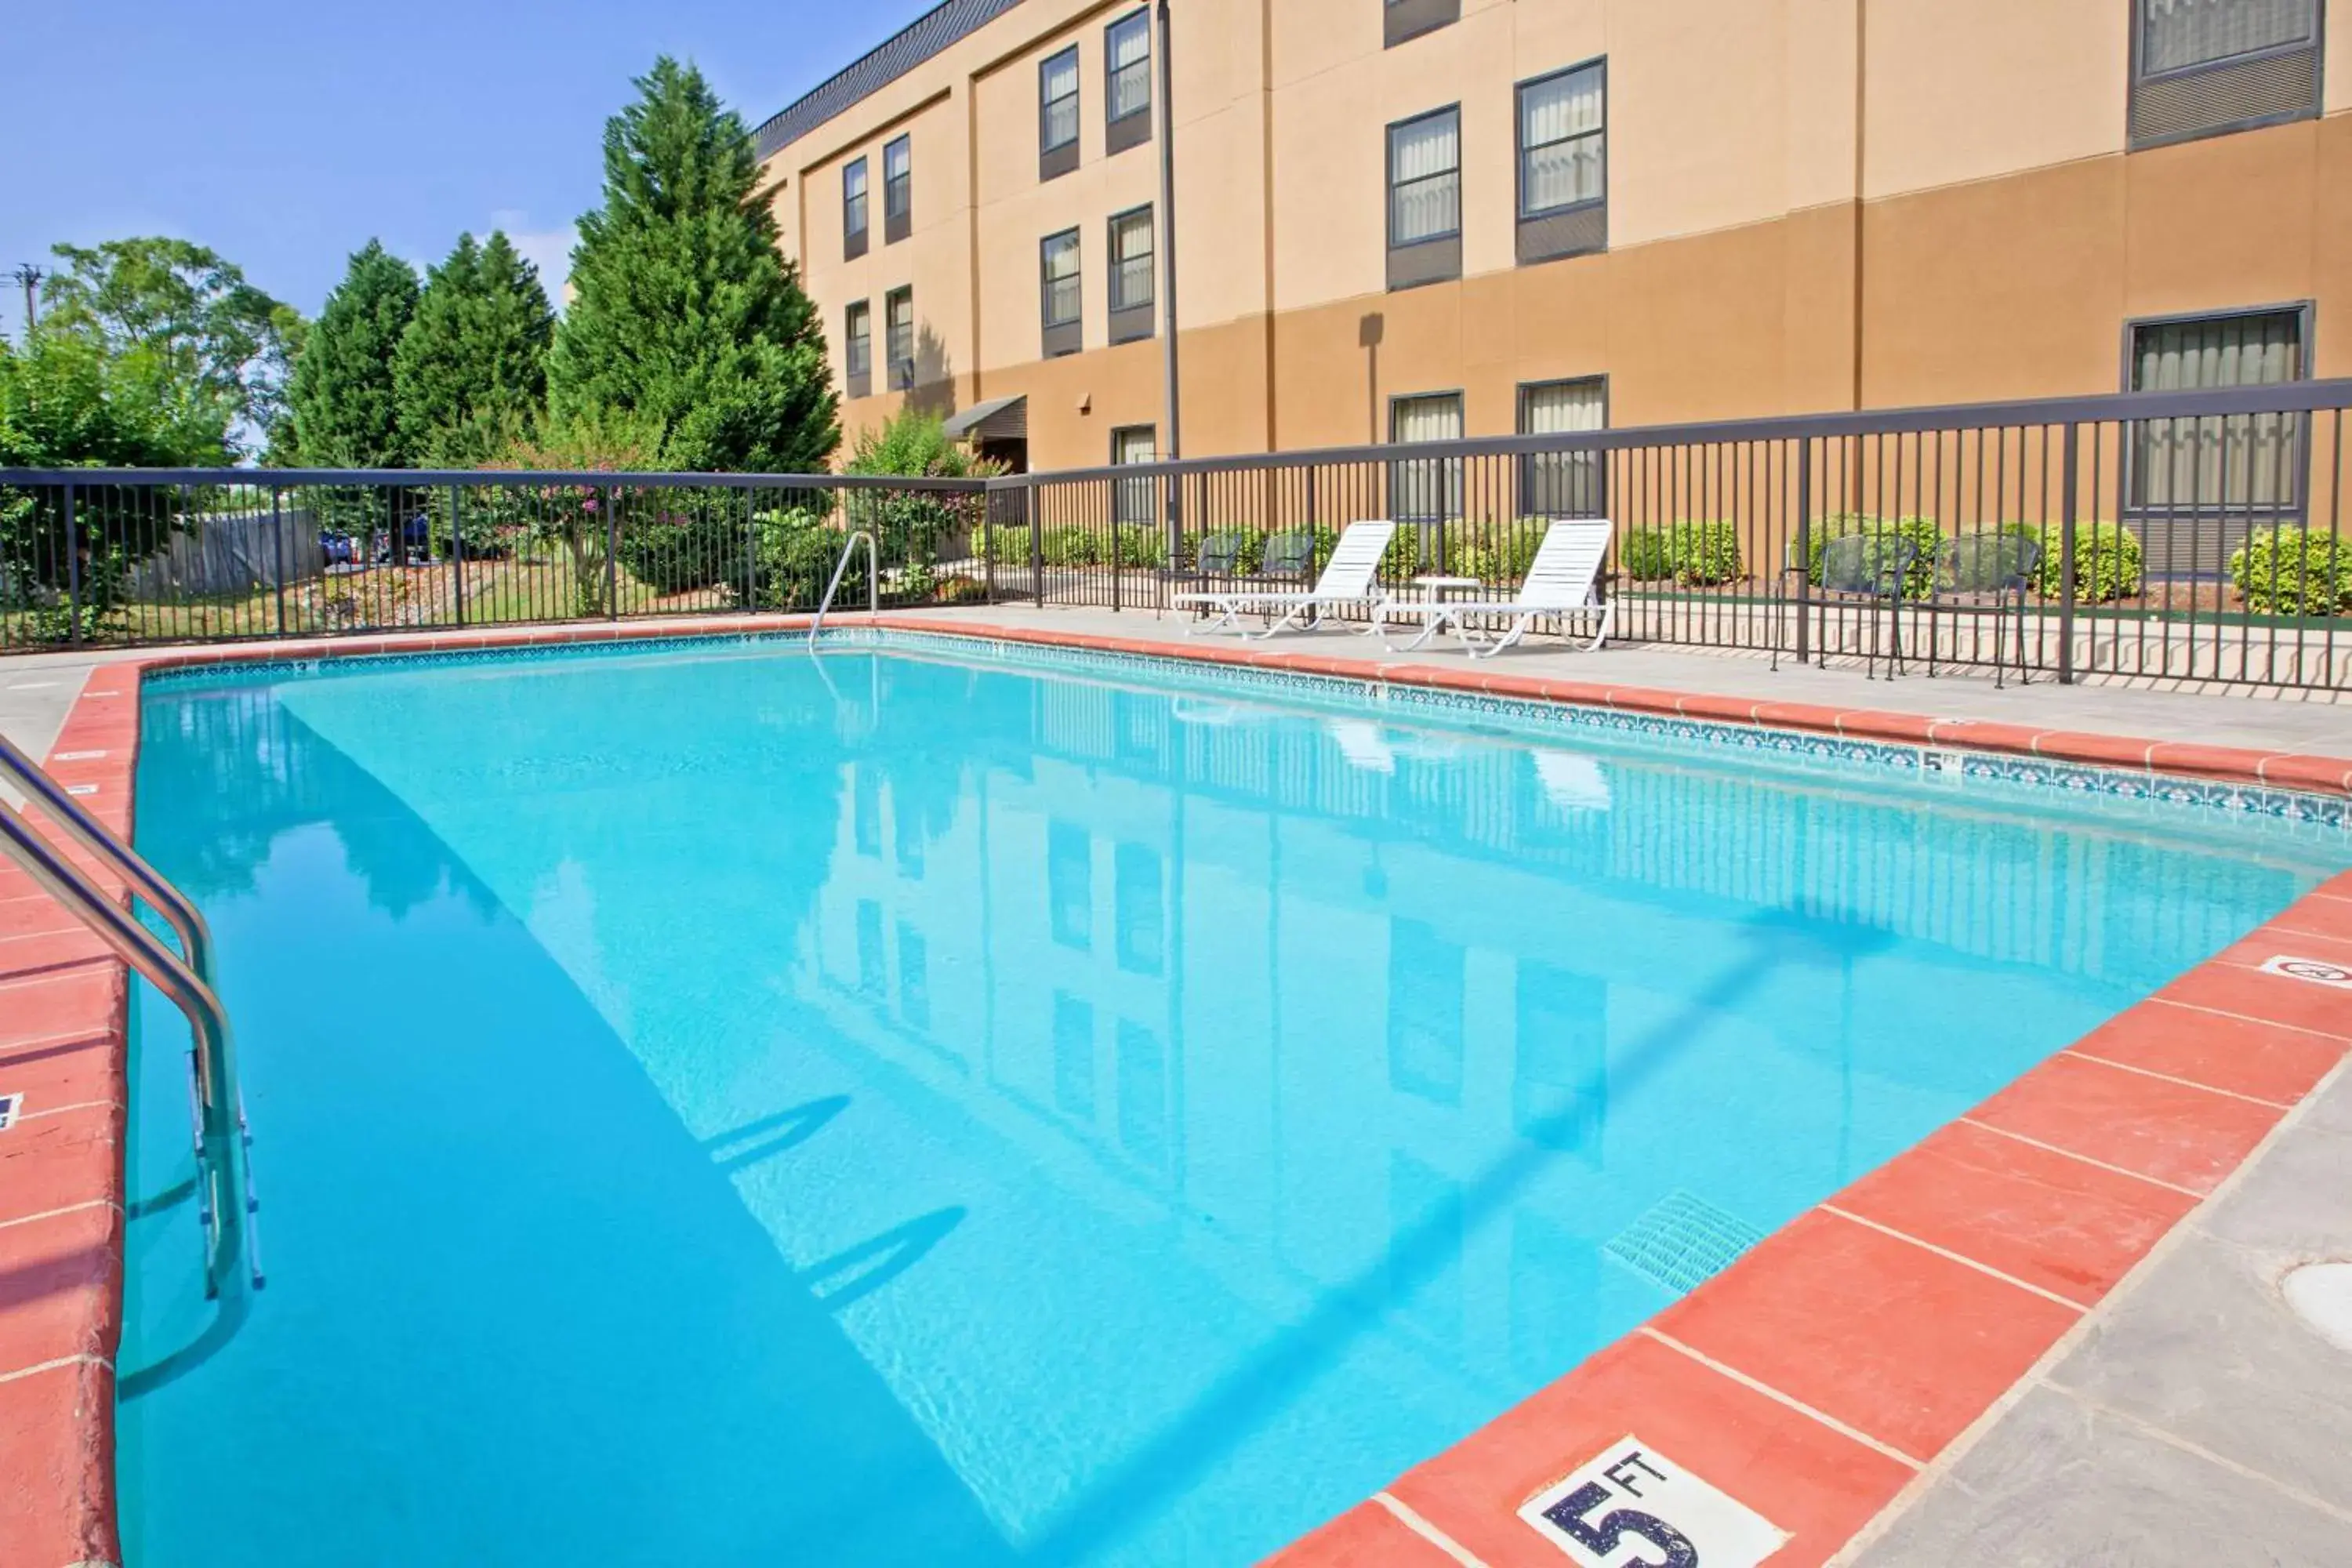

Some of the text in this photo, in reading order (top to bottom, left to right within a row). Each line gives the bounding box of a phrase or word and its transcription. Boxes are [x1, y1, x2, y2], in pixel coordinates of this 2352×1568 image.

[1924, 752, 1942, 771] 5
[1602, 1450, 1668, 1498] FT
[1541, 1480, 1699, 1568] 5
